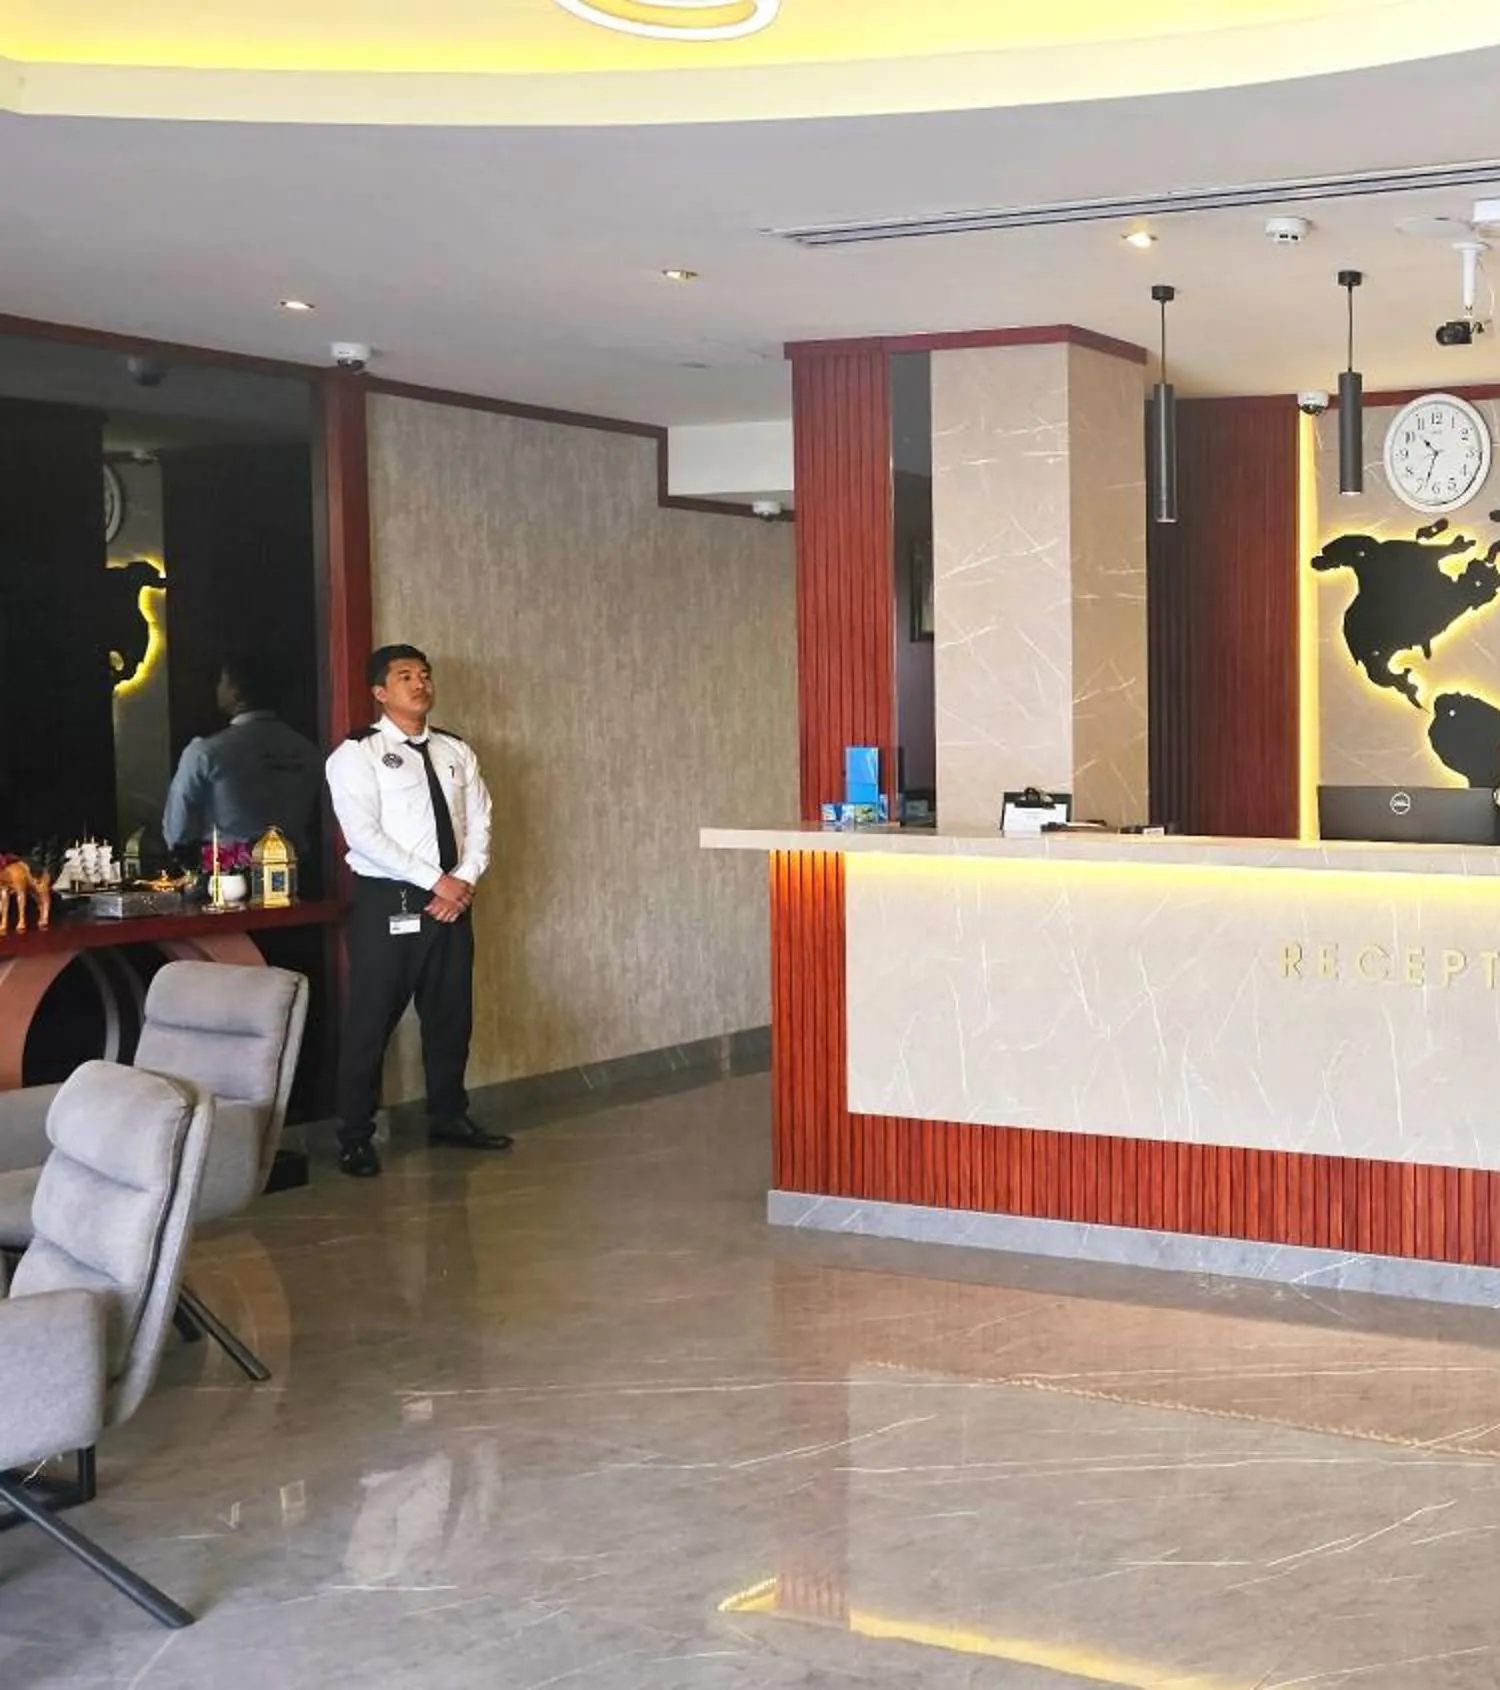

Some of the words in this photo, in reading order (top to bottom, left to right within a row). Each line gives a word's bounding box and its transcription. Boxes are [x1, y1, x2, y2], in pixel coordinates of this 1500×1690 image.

[1416, 417, 1425, 431] 11
[1431, 412, 1443, 425] 12
[1405, 431, 1416, 444] 10
[1460, 427, 1470, 441] 2
[1399, 447, 1409, 460] 9
[1415, 477, 1425, 494] 7
[1431, 481, 1441, 495] 6
[1447, 477, 1457, 491] 5
